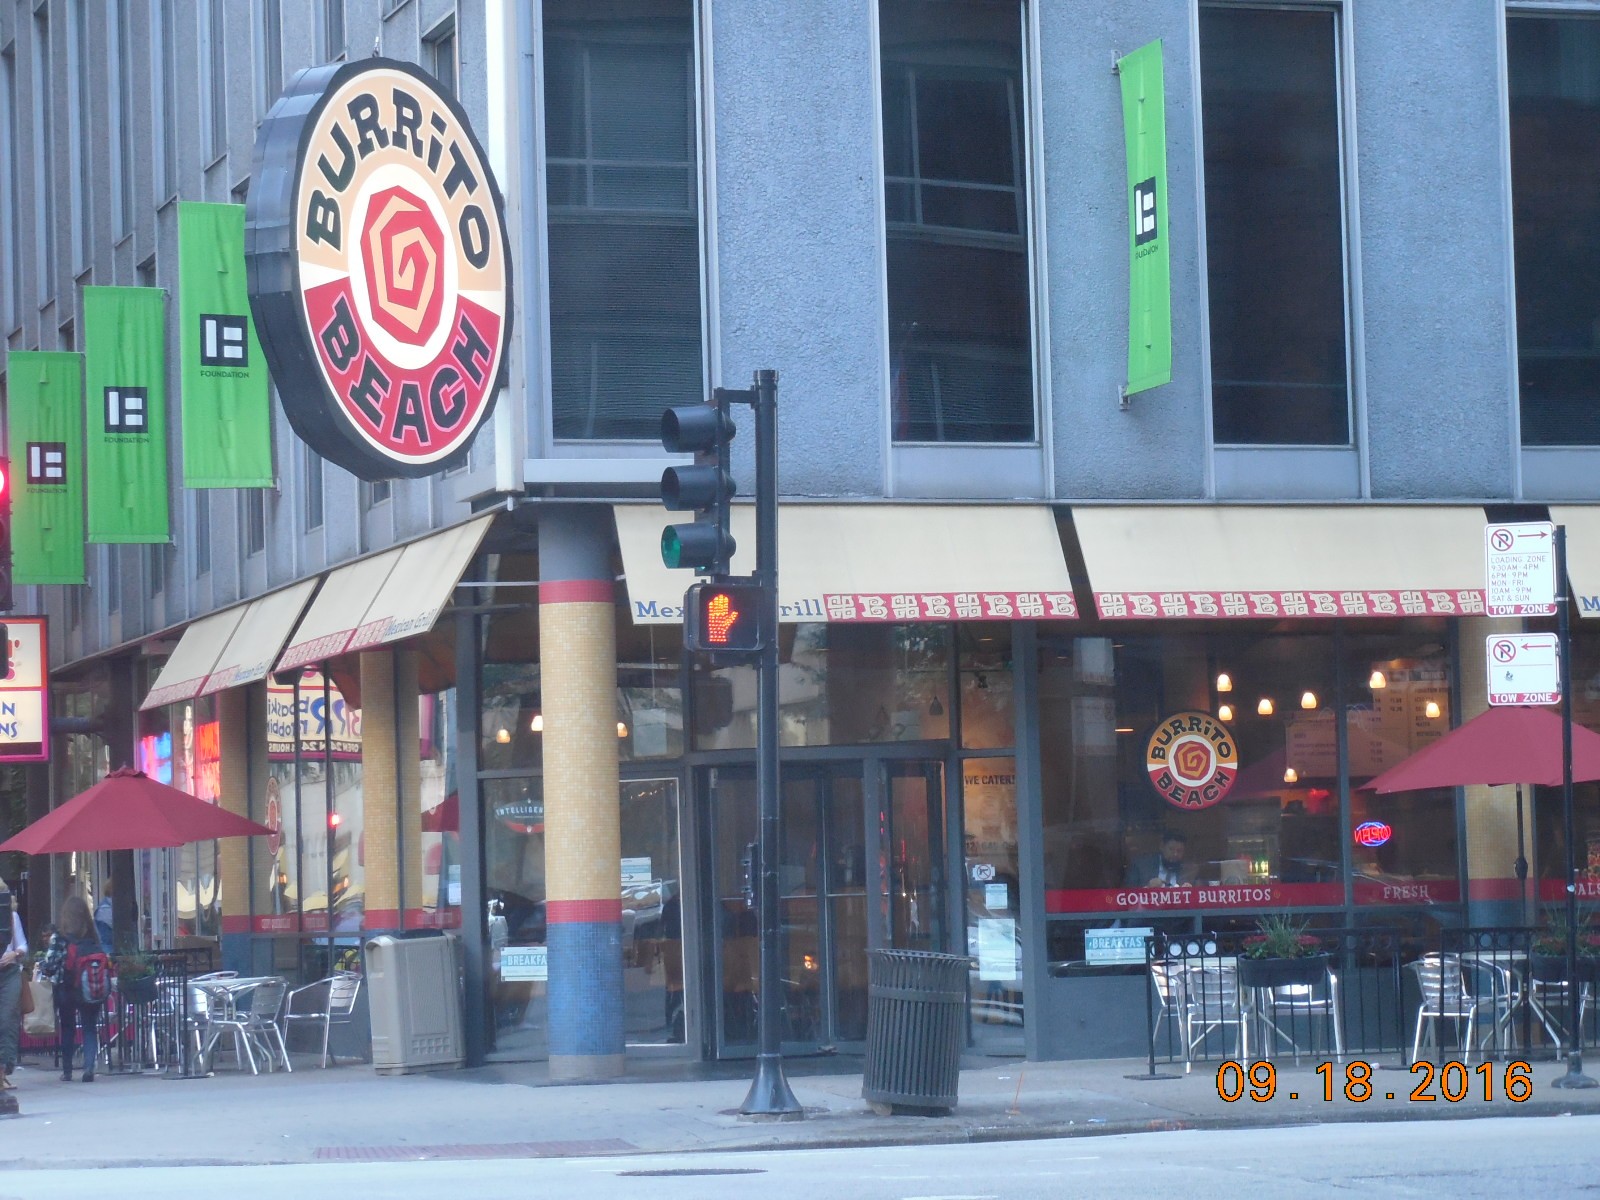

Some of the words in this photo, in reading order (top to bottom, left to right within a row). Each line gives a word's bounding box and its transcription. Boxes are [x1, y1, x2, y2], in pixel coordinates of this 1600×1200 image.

[318, 290, 493, 447] BEACH
[200, 370, 249, 379] FOUNDATION
[1490, 556, 1522, 564] LOADING
[1527, 555, 1546, 563] ZONE
[1523, 563, 1540, 571] 4PM
[1491, 572, 1507, 580] 6PM
[1512, 571, 1528, 579] 9PM
[1491, 587, 1510, 595] 10AM
[1515, 586, 1532, 594] 9PM
[1515, 594, 1530, 602] SUN
[1491, 605, 1515, 614] TOW
[1520, 604, 1550, 614] ZONE
[1493, 694, 1517, 703] TOW
[1522, 693, 1553, 703] ZONE
[965, 775, 980, 785] WE
[1156, 771, 1231, 806] BEACH
[1383, 884, 1430, 899] FRESH
[1574, 882, 1600, 896] ALS
[1116, 890, 1192, 907] GOURMET
[1198, 888, 1272, 905] BURRITOS
[1092, 936, 1144, 949] BREAKFAS
